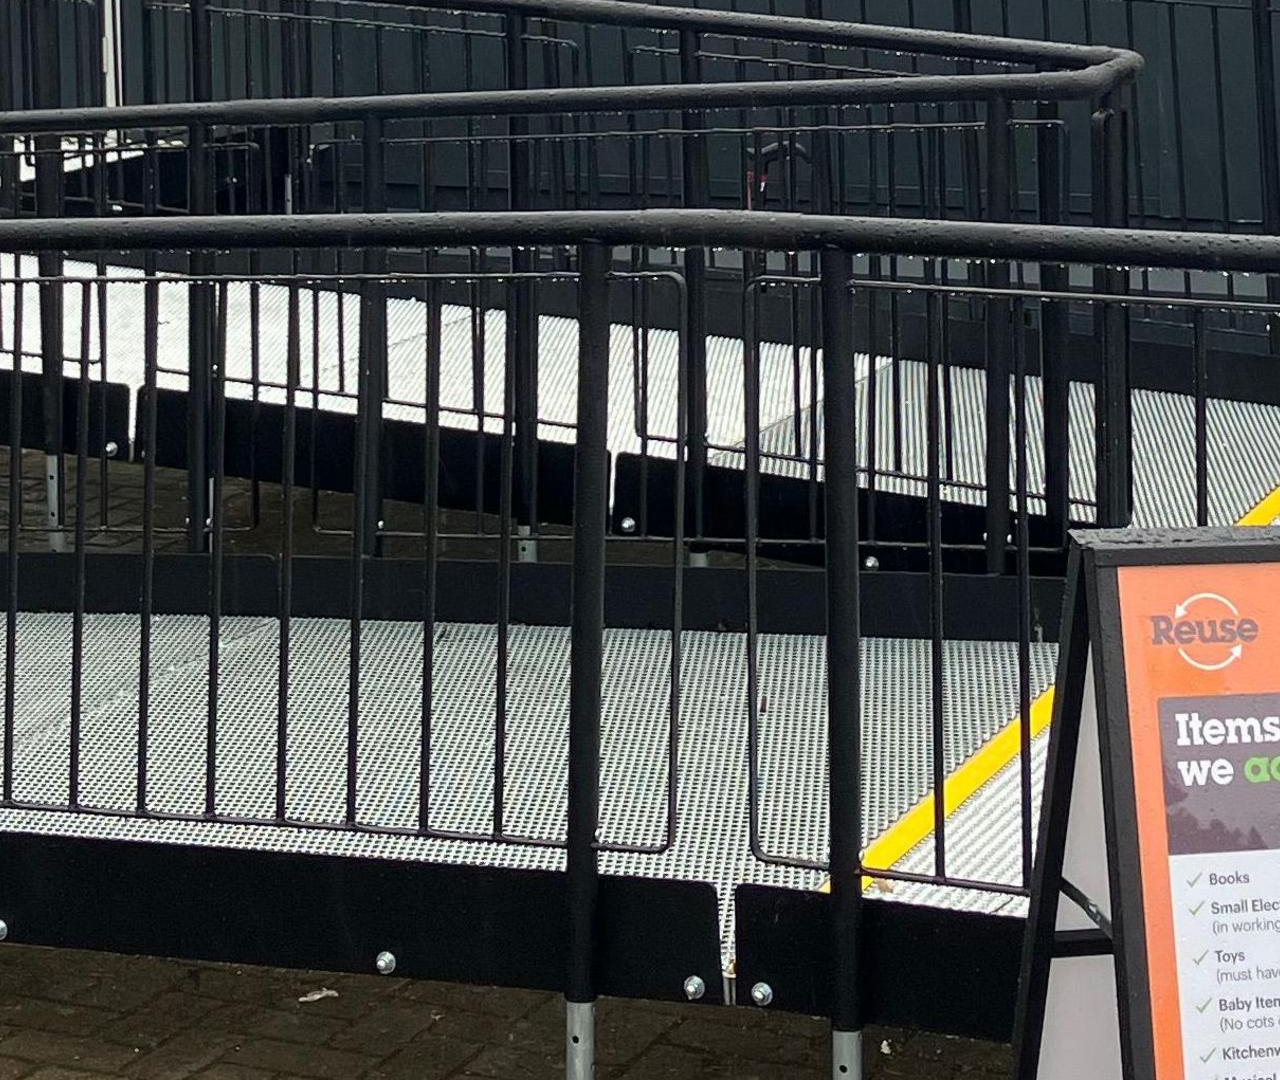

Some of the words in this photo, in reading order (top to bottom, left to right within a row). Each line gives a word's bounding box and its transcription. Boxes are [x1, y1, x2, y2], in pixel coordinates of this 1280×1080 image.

[1151, 615, 1259, 645] Reuse
[1177, 758, 1234, 787] we
[1209, 871, 1250, 886] Books
[1210, 899, 1248, 915] Small
[1212, 922, 1228, 935] (in
[1215, 950, 1246, 965] Toys
[1216, 969, 1252, 984] (must
[1219, 997, 1252, 1012] Baby
[1220, 1018, 1243, 1033] (No
[1247, 1017, 1274, 1030] cots
